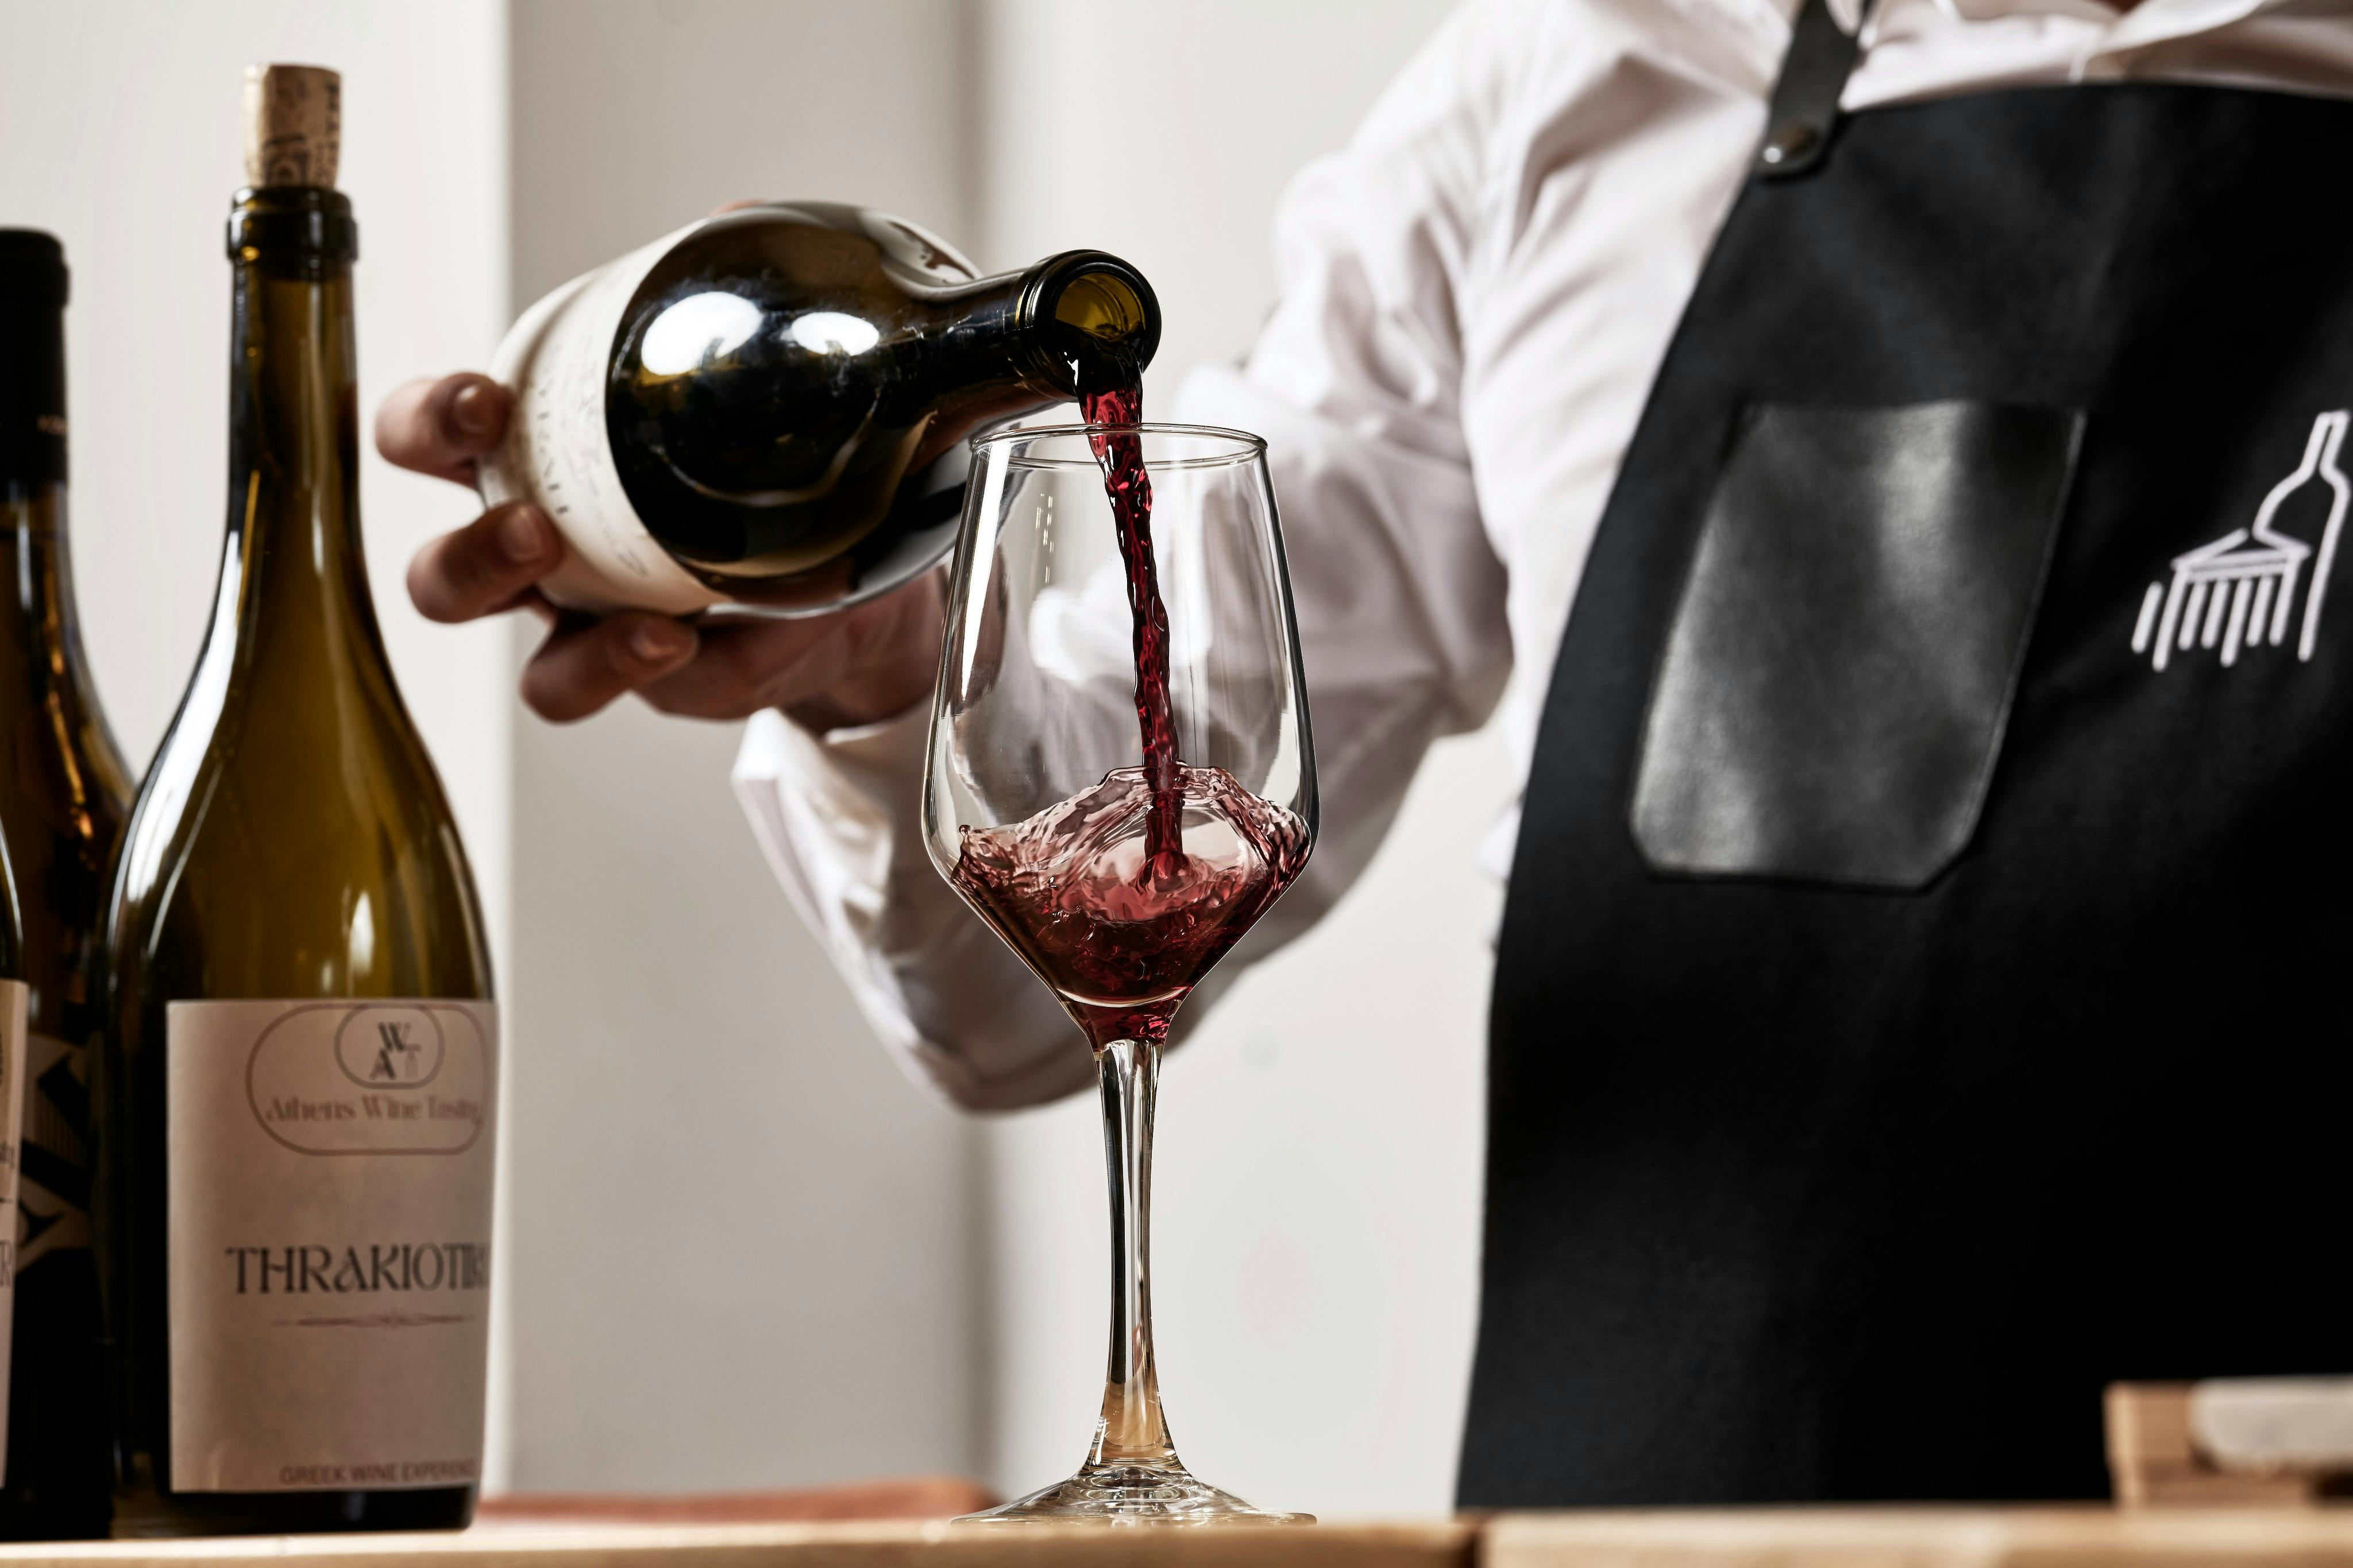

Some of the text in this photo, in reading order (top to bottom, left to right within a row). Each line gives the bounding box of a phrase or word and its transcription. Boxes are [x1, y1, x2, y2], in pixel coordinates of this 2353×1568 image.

[265, 1096, 356, 1122] Athens
[361, 1094, 422, 1121] Wine
[279, 1463, 346, 1485] GREEK
[350, 1463, 397, 1482] WINE
